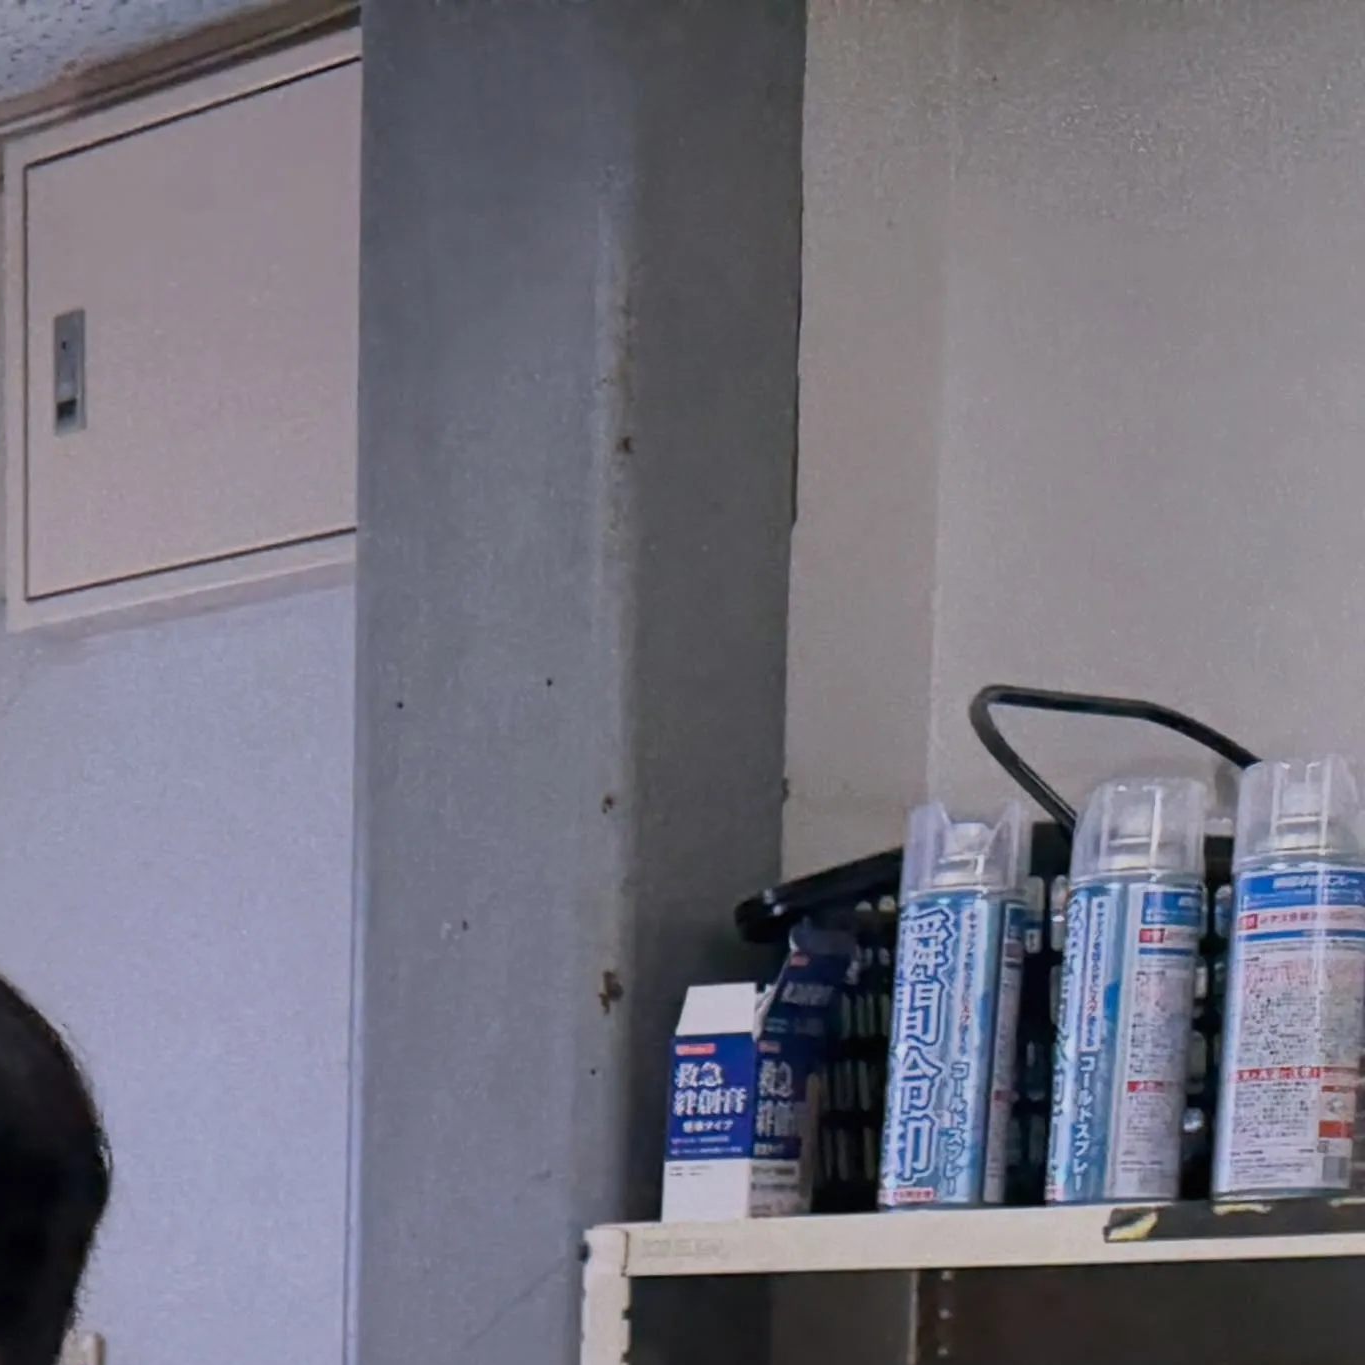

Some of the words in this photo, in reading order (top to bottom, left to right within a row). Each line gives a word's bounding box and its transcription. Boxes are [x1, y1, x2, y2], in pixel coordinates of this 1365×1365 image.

[673, 1061, 724, 1090] 救急
[941, 1061, 971, 1196] コールドスプレー
[1072, 1055, 1096, 1190] コールドスプレー
